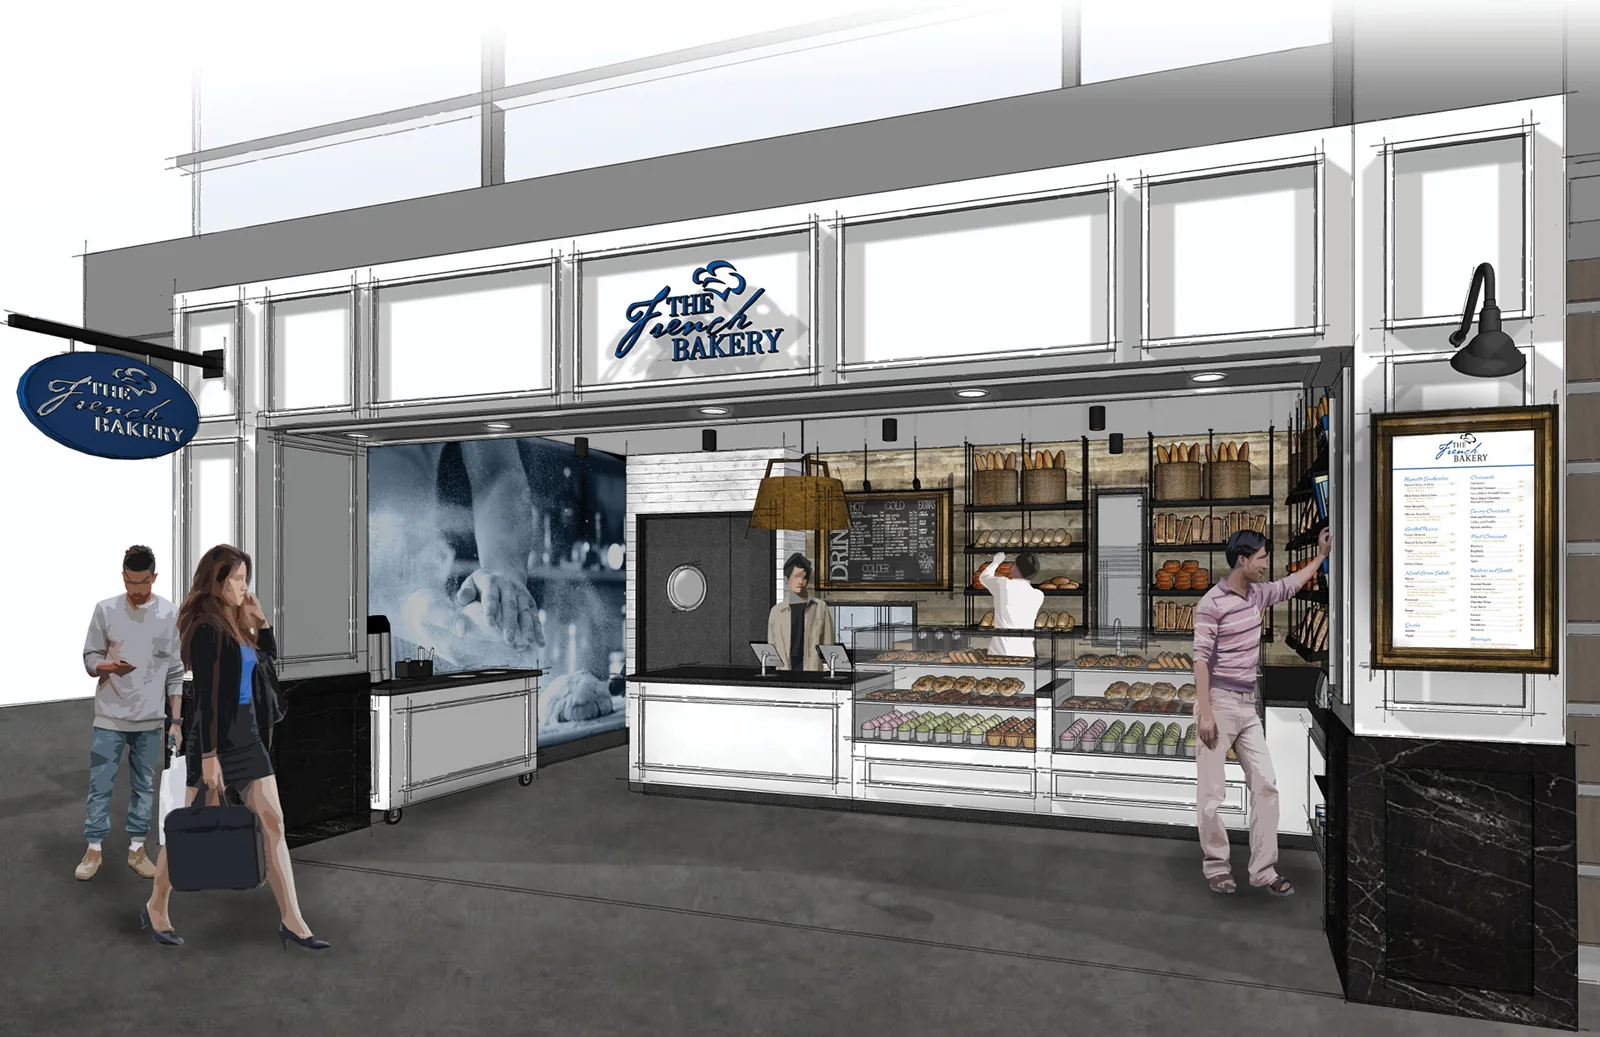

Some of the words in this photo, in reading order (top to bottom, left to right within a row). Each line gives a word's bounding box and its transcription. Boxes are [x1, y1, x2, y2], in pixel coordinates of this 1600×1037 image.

[666, 292, 714, 317] THE
[615, 285, 766, 359] French
[671, 328, 785, 362] BAKERY
[37, 375, 172, 421] French
[88, 380, 131, 401] THE
[94, 416, 185, 443] BAKERY
[1435, 440, 1483, 460] French
[1453, 441, 1467, 449] THE
[1453, 454, 1488, 462] BAKERY
[850, 501, 866, 511] HOT
[885, 501, 905, 511] COLD
[830, 529, 849, 581] DRIN
